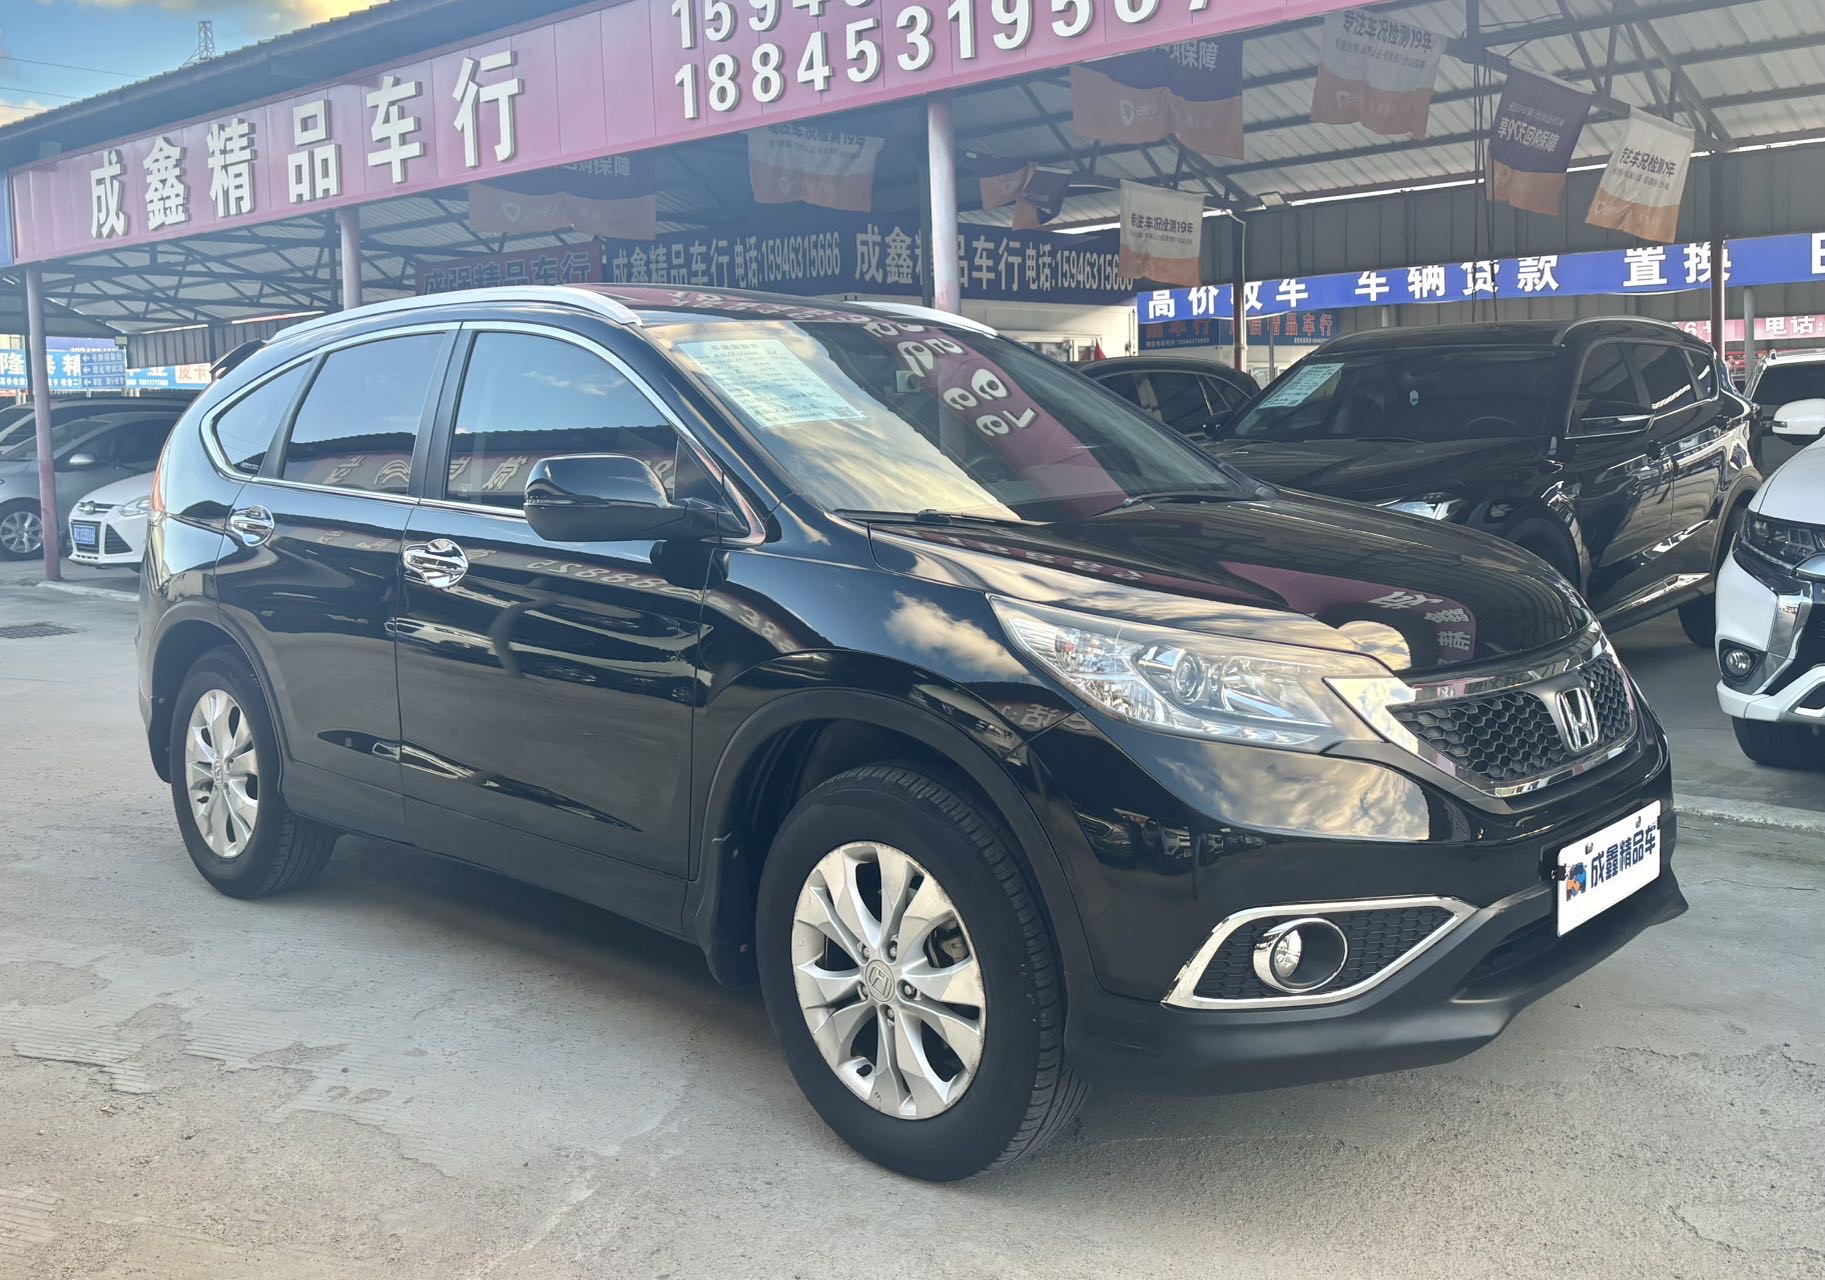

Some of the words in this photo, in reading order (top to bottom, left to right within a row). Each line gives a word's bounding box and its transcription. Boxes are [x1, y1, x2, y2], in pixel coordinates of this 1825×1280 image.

[675, 0, 1208, 119] 188453195
[90, 50, 523, 239] 成鑫精品车行
[613, 238, 730, 288] 成鑫精品车行
[1590, 825, 1656, 889] 成鑫精品车
